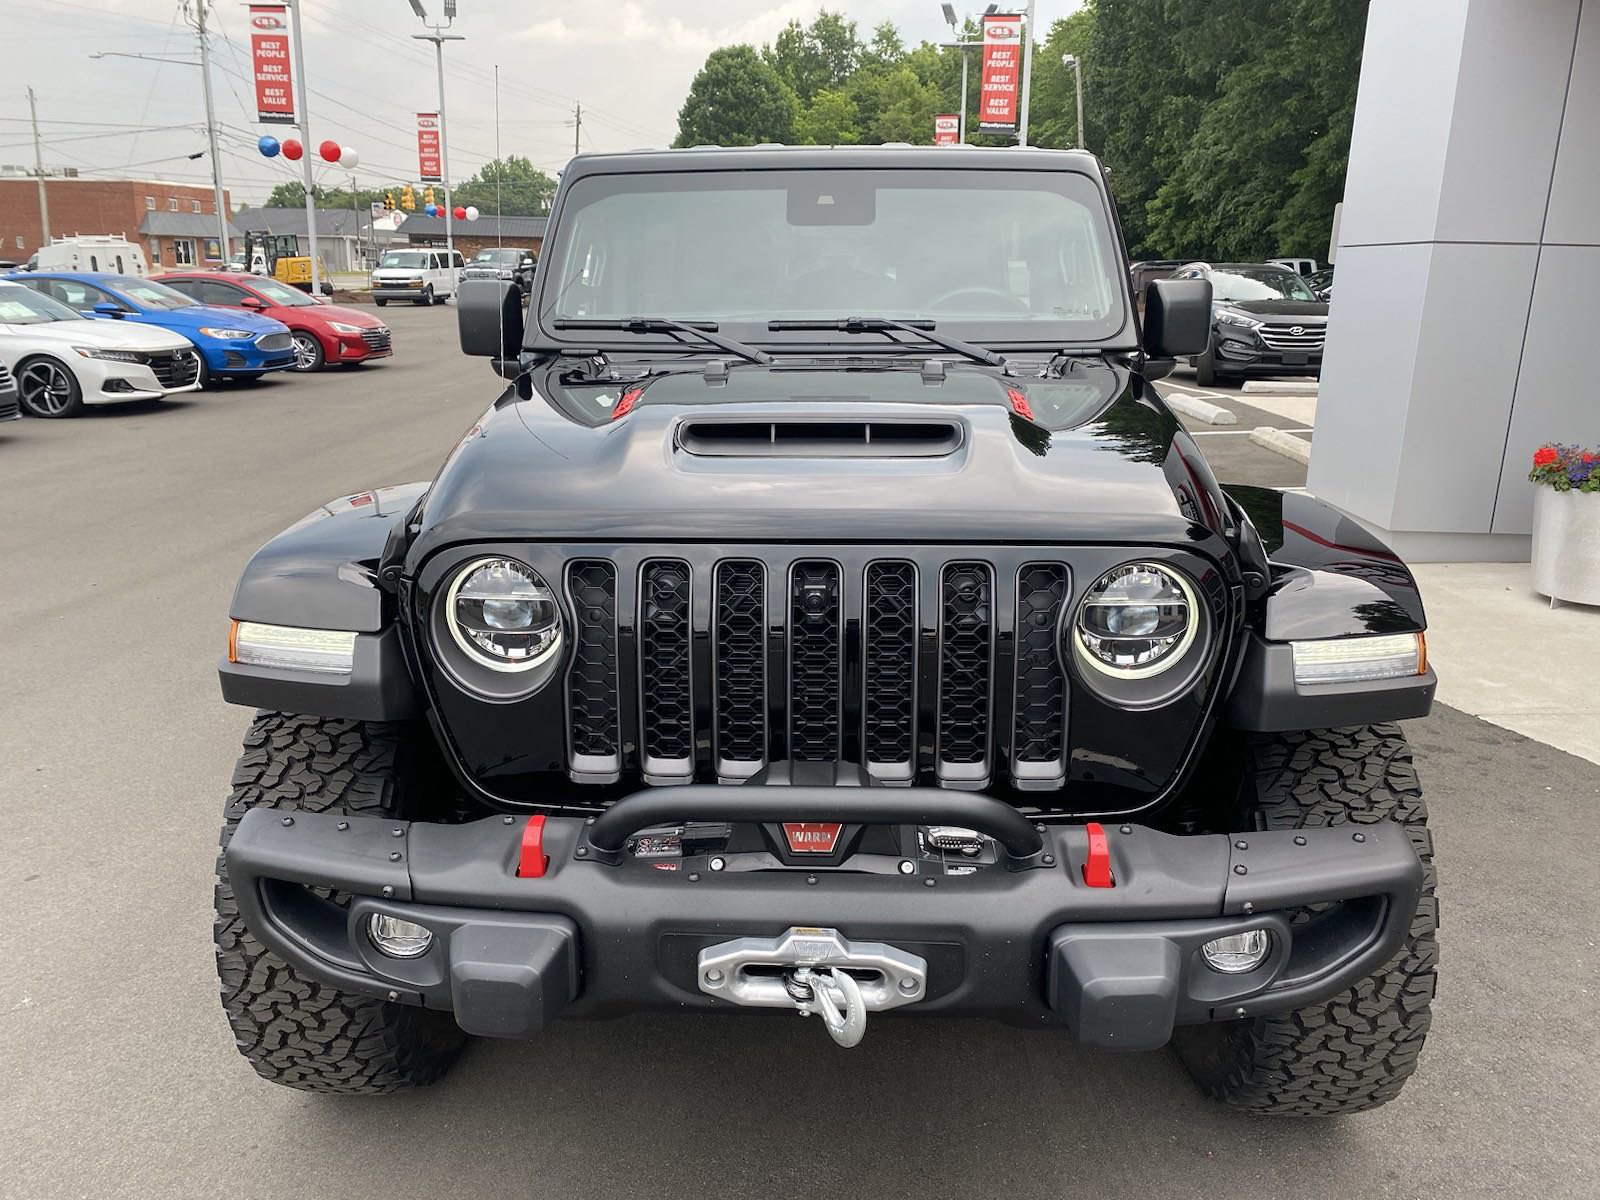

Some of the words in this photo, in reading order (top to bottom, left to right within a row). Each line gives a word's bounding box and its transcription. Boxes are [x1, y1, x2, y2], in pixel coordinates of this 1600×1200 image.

[261, 41, 280, 49] BEST
[256, 49, 286, 58] PEOPLE
[992, 51, 1011, 59] BEST
[986, 60, 1015, 68] PEOPLE
[256, 73, 289, 82] SERVICE
[991, 75, 1010, 83] BEST
[264, 88, 284, 96] BEST
[983, 84, 1015, 92] SERVICE
[262, 96, 287, 105] VALUE
[989, 98, 1009, 107] BEST
[986, 107, 1010, 115] VALUE
[792, 831, 831, 842] WARN
